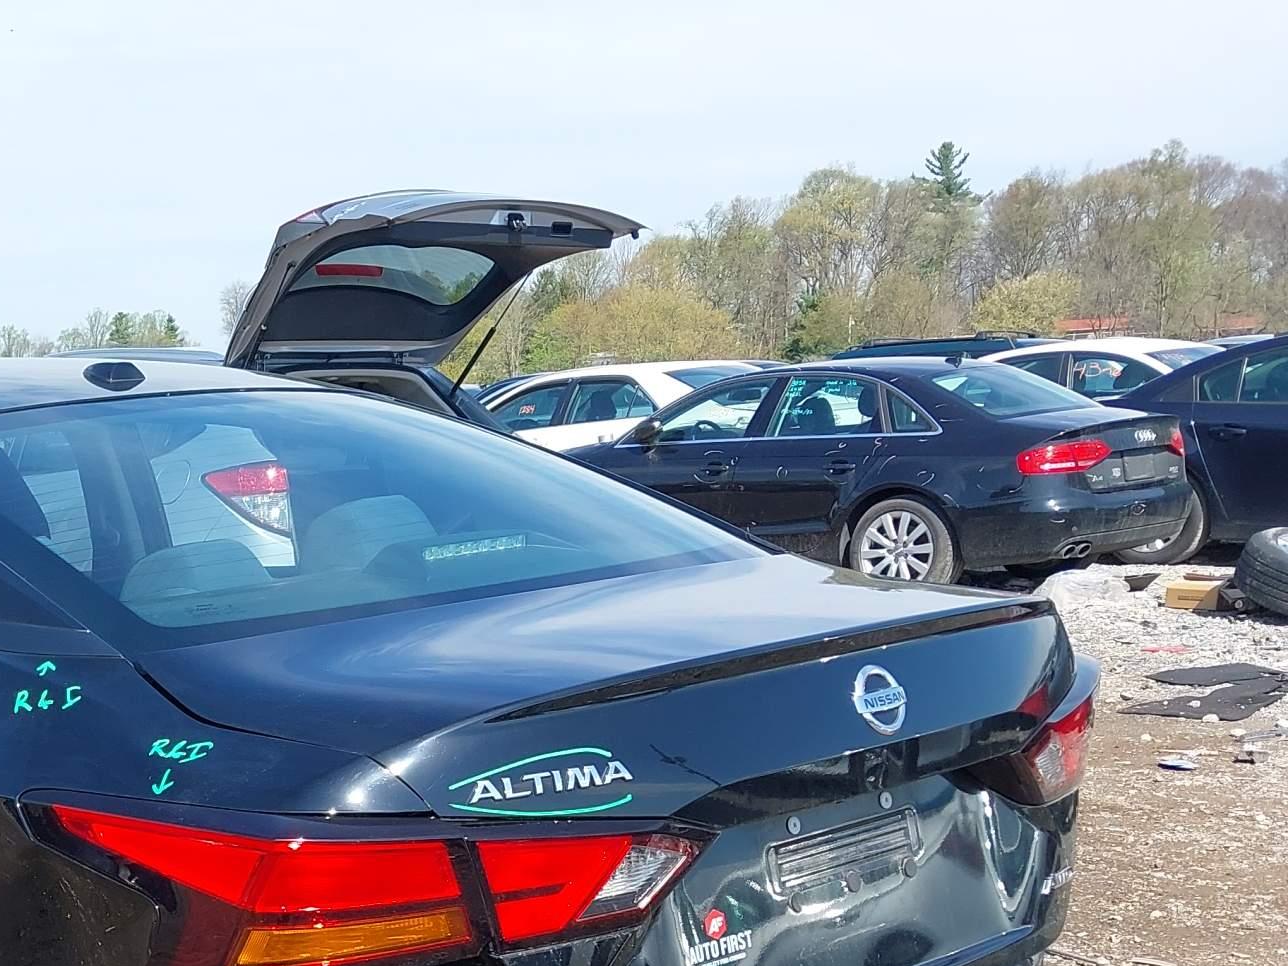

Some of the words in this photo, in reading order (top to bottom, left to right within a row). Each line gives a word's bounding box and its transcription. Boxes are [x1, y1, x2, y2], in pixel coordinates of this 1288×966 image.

[863, 690, 905, 710] NISSAN
[467, 760, 634, 805] ALTIMA
[688, 940, 720, 966] AUTO
[719, 929, 753, 956] FIRST
